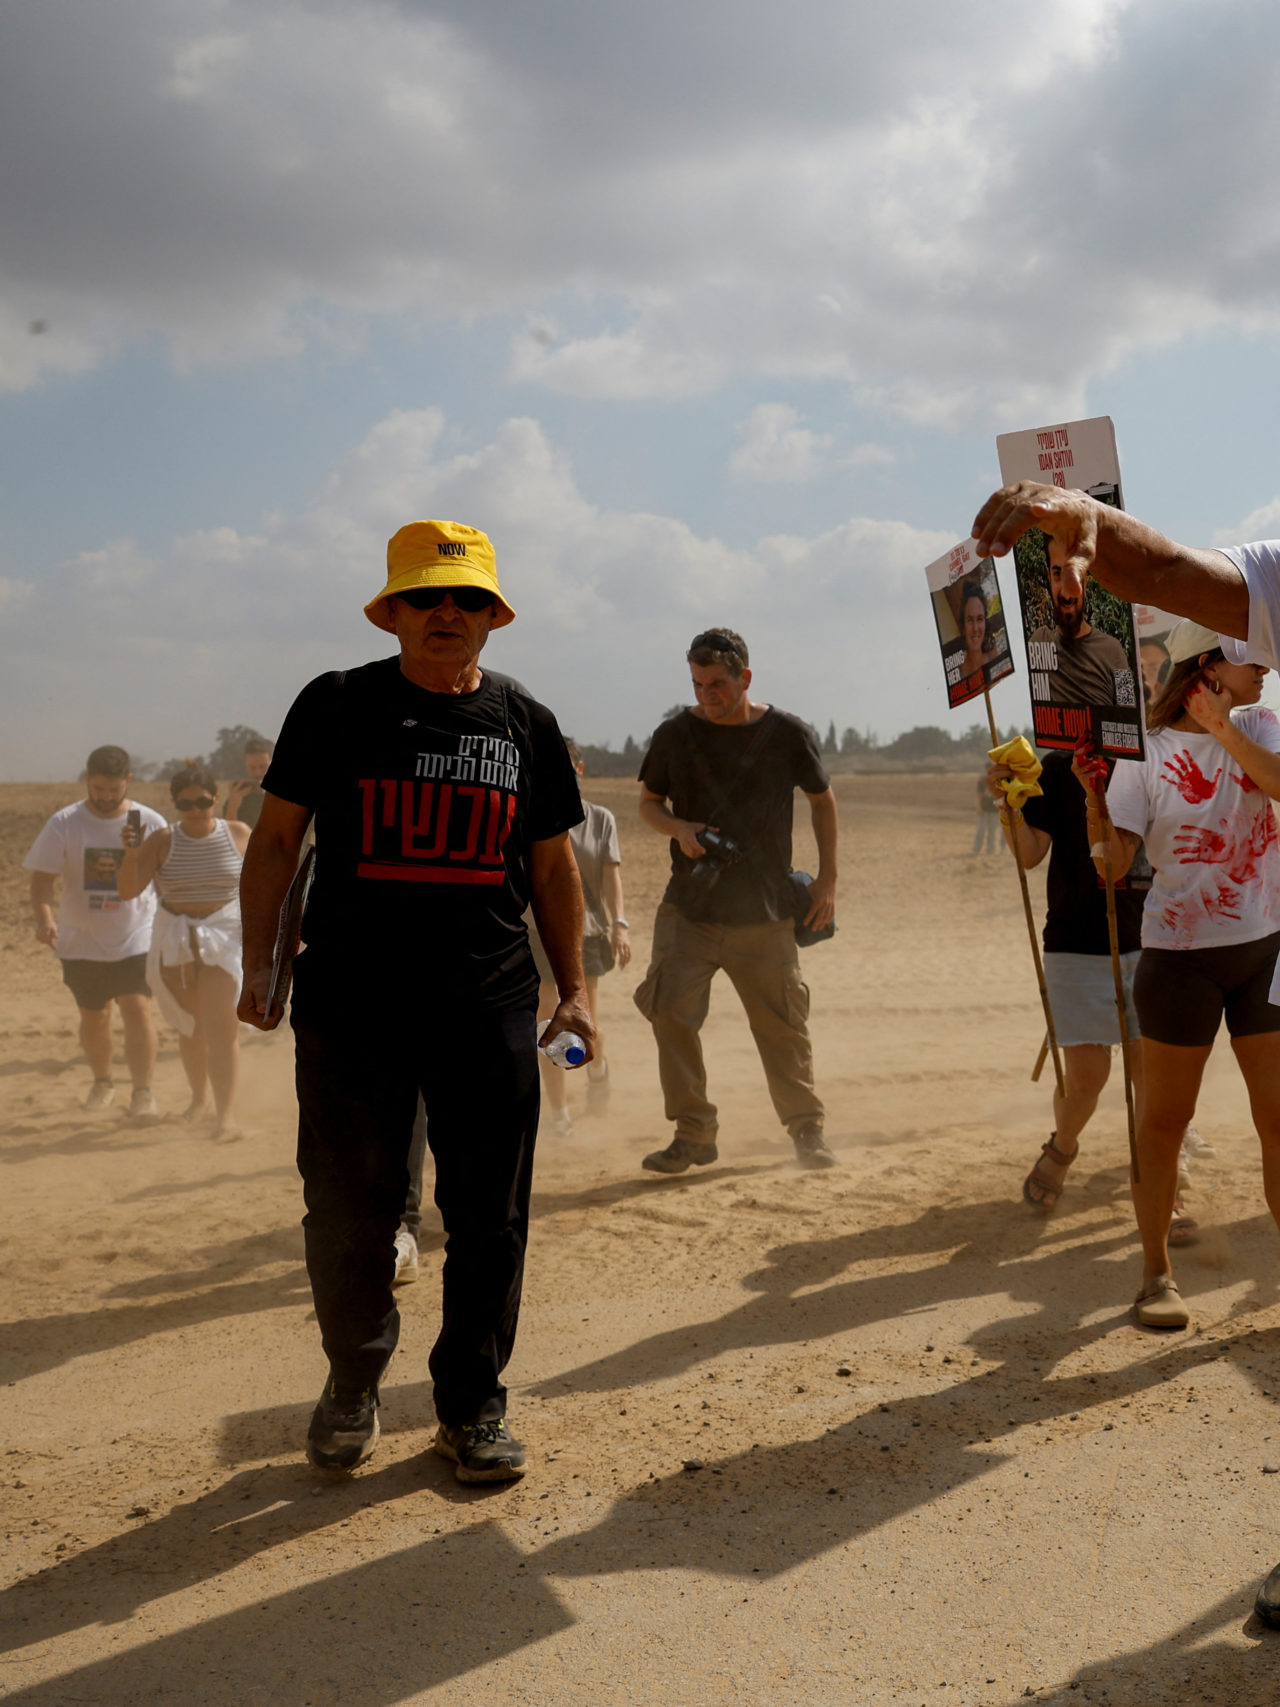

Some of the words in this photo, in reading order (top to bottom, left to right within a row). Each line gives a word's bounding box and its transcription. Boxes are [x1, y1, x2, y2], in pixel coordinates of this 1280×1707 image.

[1038, 453, 1053, 471] IDAN
[944, 649, 965, 672] BRING
[1028, 641, 1058, 671] BRING
[947, 667, 961, 686] HER
[1031, 672, 1051, 702] HIM
[1034, 705, 1062, 736] HOME
[415, 752, 476, 781] הביתה
[479, 758, 519, 792] אותם
[358, 779, 517, 865] עכשיו
